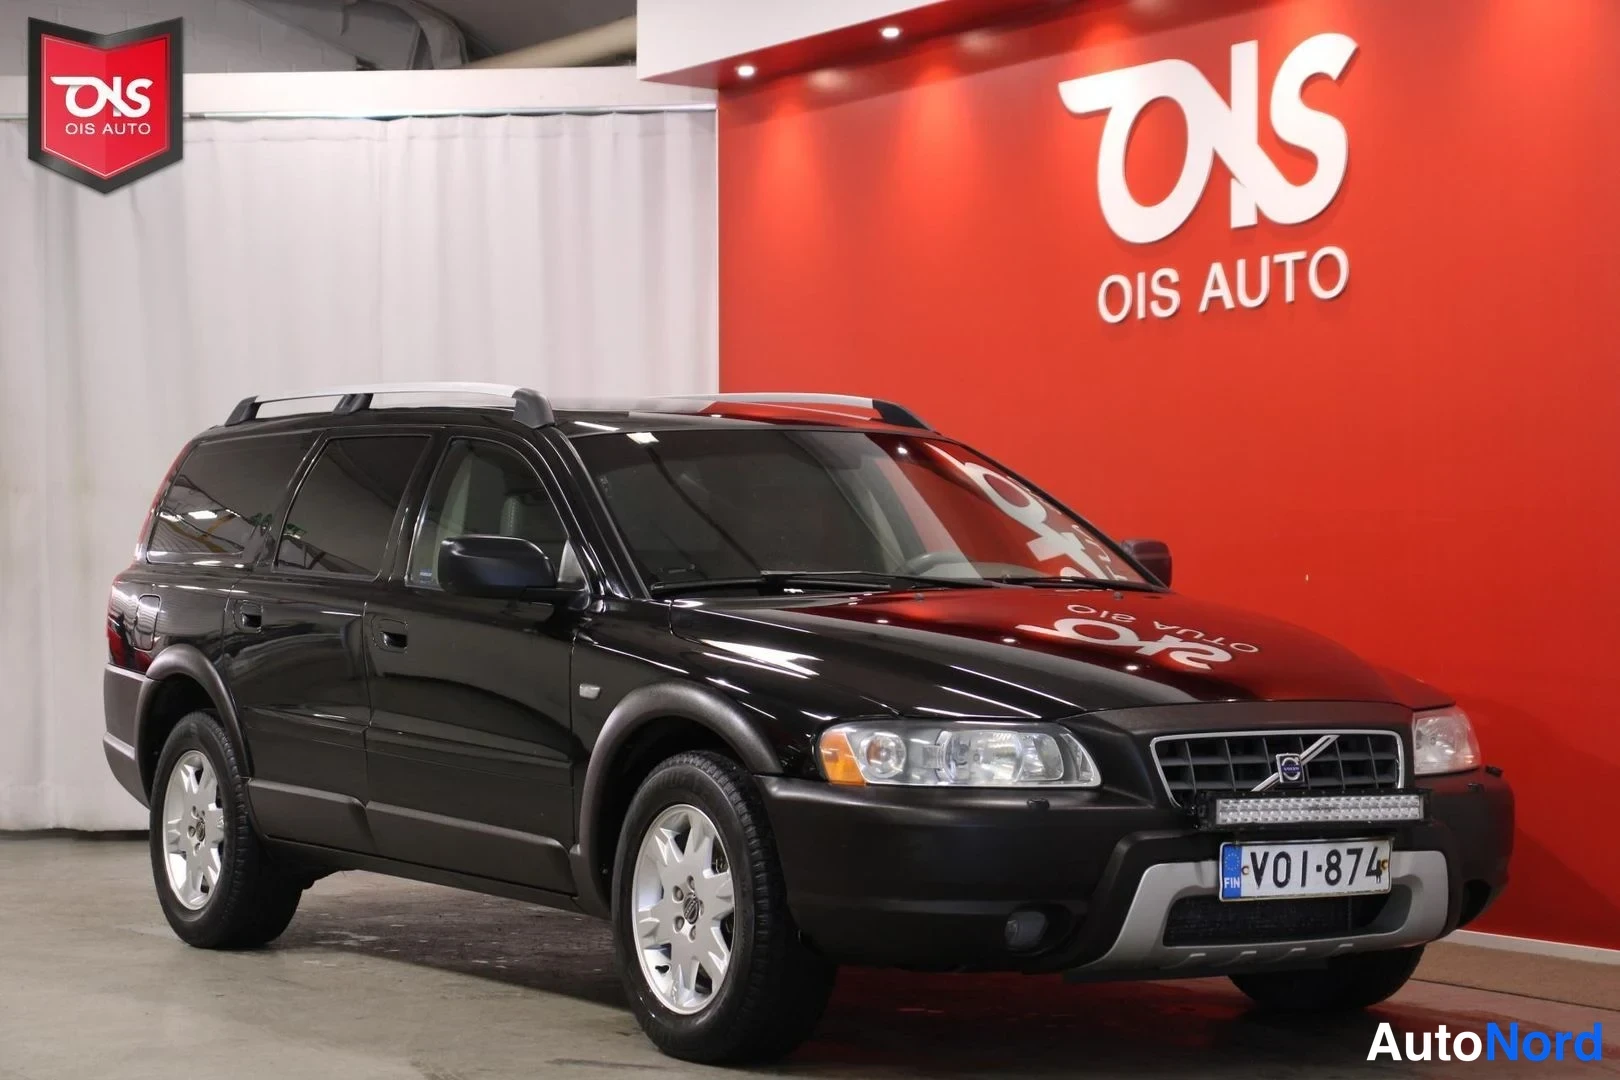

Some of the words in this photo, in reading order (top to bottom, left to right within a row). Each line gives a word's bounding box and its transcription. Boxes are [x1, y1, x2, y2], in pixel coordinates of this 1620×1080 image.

[1098, 268, 1180, 323] OIS
[1199, 246, 1349, 312] AUTO
[1224, 877, 1240, 888] FIN
